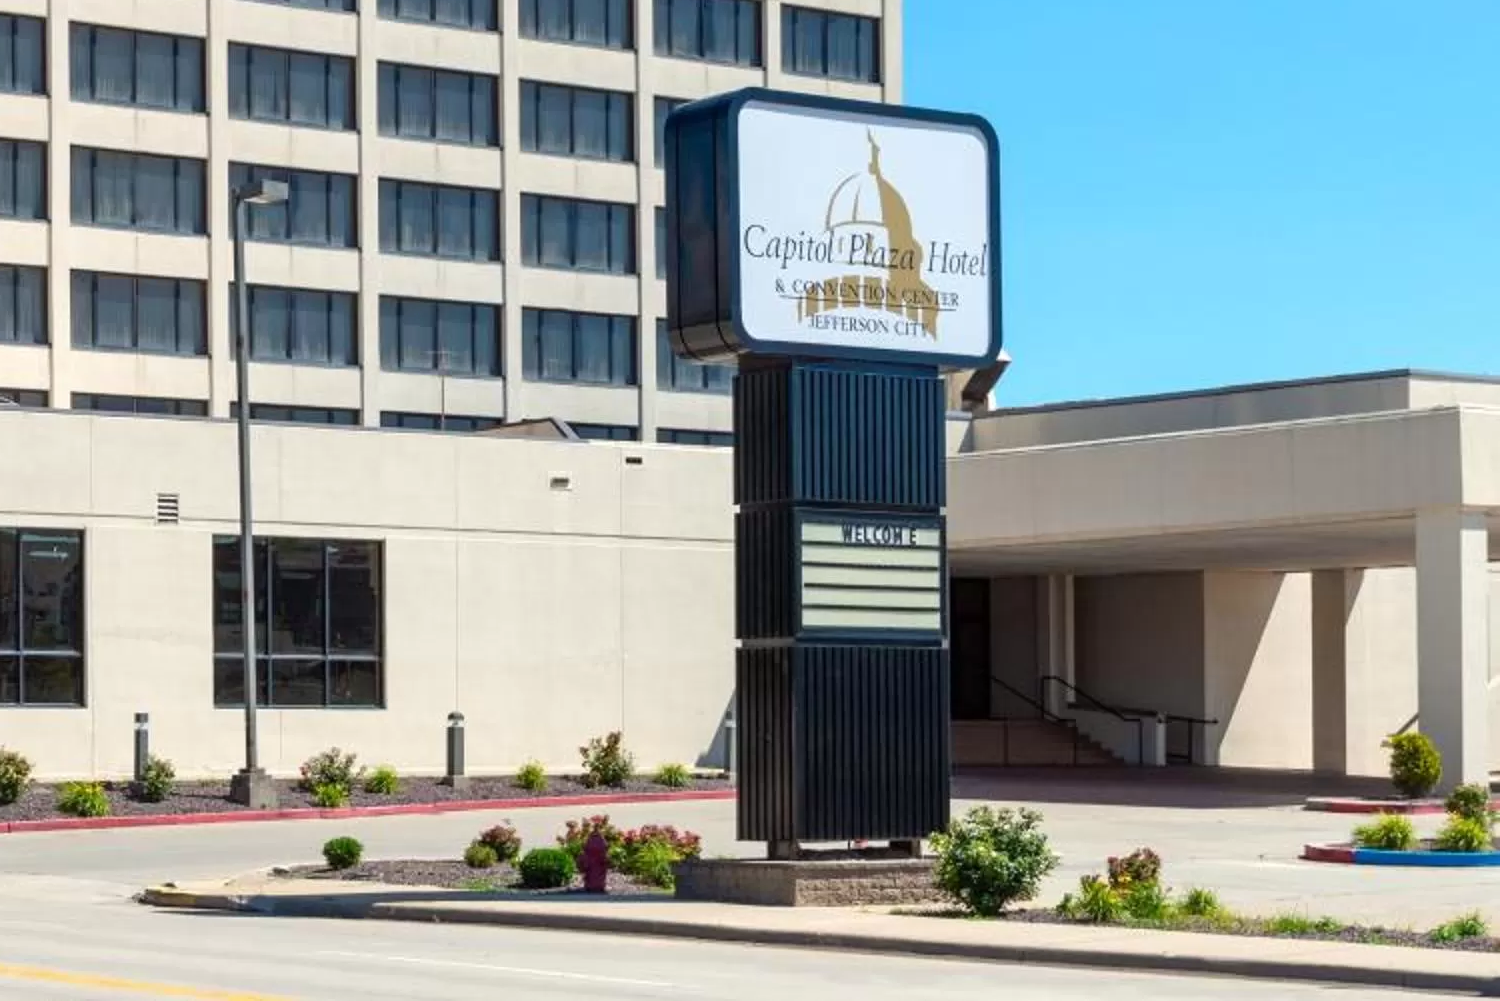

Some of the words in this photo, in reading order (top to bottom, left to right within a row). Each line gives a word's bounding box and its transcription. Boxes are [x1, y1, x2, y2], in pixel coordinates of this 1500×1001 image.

[744, 224, 835, 269] Capitol
[848, 233, 915, 271] Plaza
[927, 241, 988, 276] Hotel
[774, 279, 785, 293] &
[792, 279, 897, 302] CONVENTION
[901, 290, 960, 307] CENTER
[808, 315, 889, 334] JEFFERSON
[894, 322, 929, 337] CITY
[842, 524, 917, 545] WELCOME
